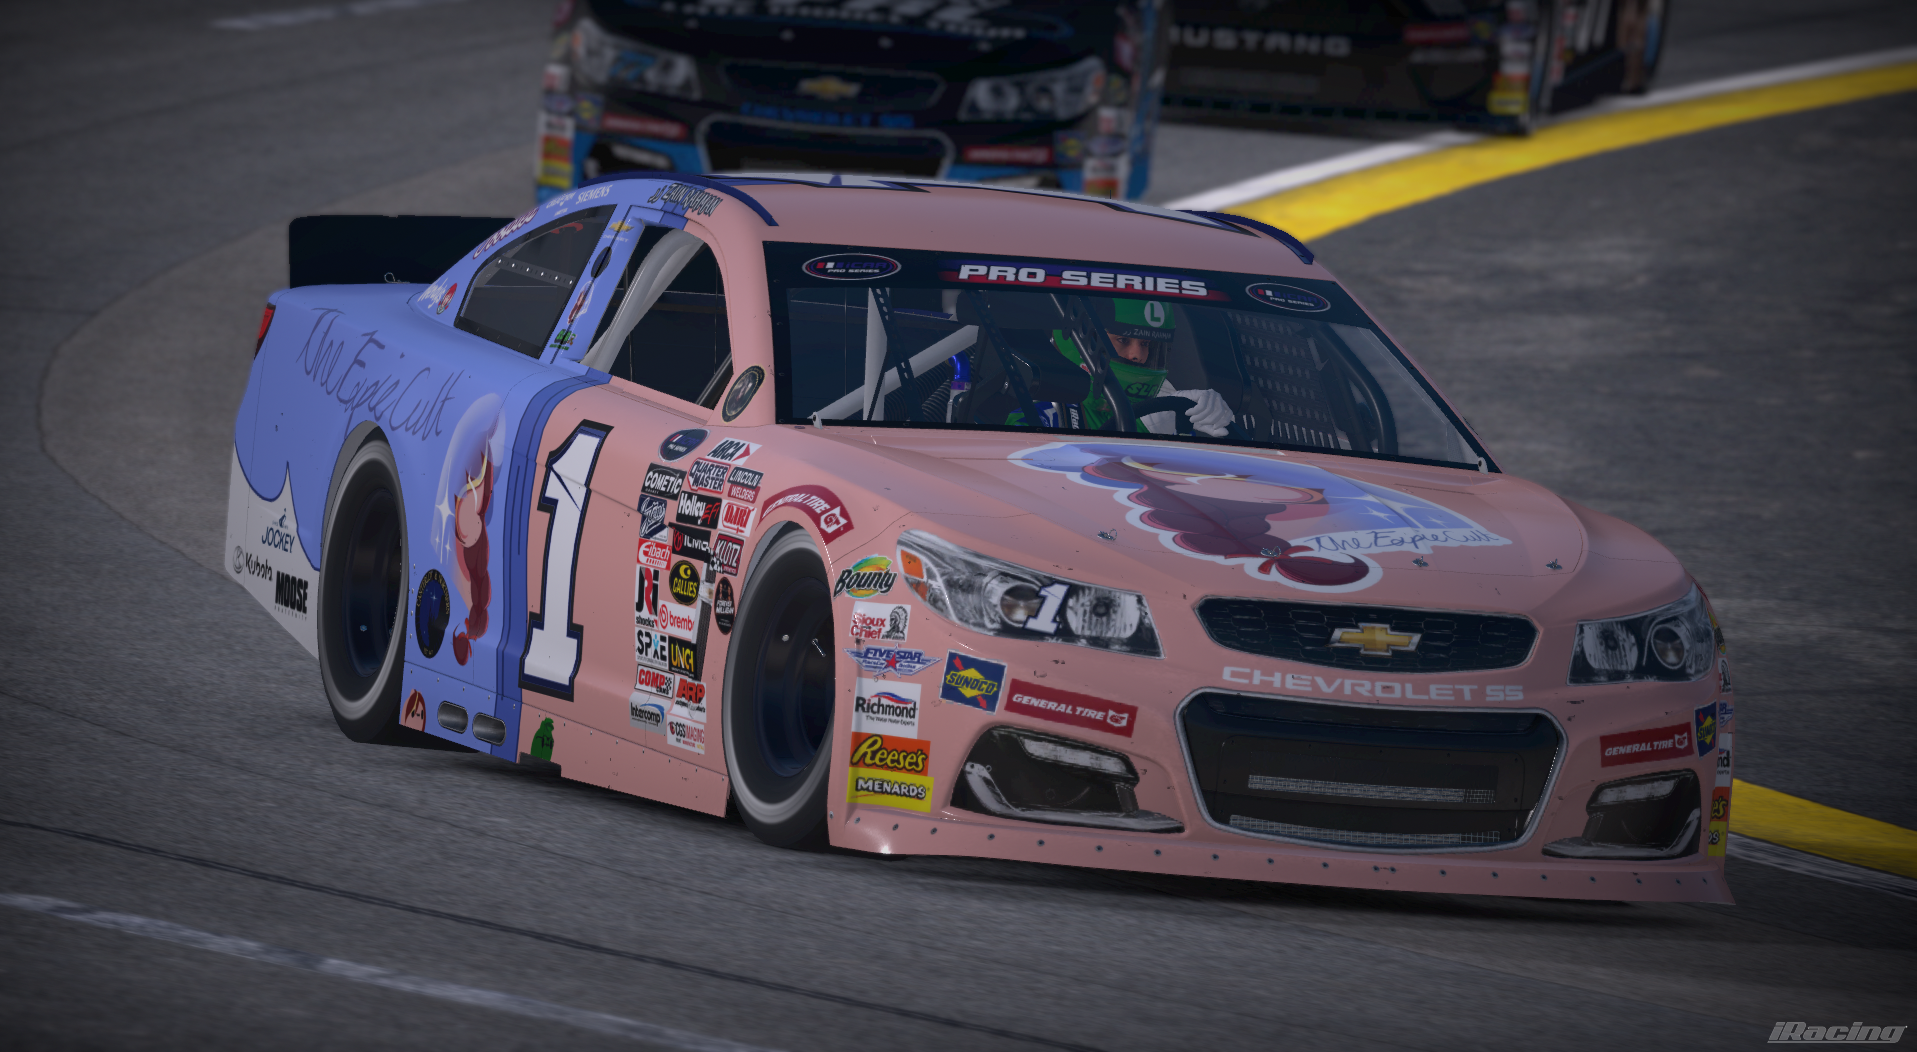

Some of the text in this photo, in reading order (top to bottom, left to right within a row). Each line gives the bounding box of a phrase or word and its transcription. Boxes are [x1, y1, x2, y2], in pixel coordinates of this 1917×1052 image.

[575, 184, 614, 205] SIEMENS
[659, 182, 691, 204] ZAIN
[679, 188, 723, 217] RAHMAN
[958, 264, 1208, 296] PRO SERIES
[1150, 303, 1161, 322] L
[1133, 328, 1151, 337] ZAIN
[295, 307, 346, 395] The
[389, 367, 465, 441] Cult
[706, 439, 746, 462] ARCA
[689, 461, 727, 479] QUARTER
[729, 469, 761, 488] LINCOLN
[644, 470, 683, 495] COMETIC
[692, 475, 725, 491] MASTER
[730, 485, 756, 502] WELDERS
[678, 492, 707, 526] Holley
[701, 502, 721, 525] EFI
[761, 493, 811, 519] GENERAL
[806, 495, 831, 514] TIRE
[261, 527, 295, 554] JOCKEY
[638, 541, 670, 563] Eibach
[1303, 535, 1373, 551] The
[519, 420, 613, 701] 1
[714, 539, 741, 568] KLOTZ
[245, 553, 273, 582] Kubota
[275, 570, 309, 614] MOOSE
[672, 577, 698, 598] CALLIES
[834, 569, 898, 597] Bounty
[1024, 582, 1071, 635] 1
[635, 615, 655, 628] shocks
[850, 625, 882, 639] Chief
[852, 613, 886, 628] Sioux
[864, 647, 923, 663] FIVE STAR
[638, 668, 666, 689] COMP
[946, 672, 998, 695] SUNOCO
[1222, 666, 1524, 702] CHEVROLET SS
[676, 677, 706, 704] ARP
[630, 702, 661, 728] Intercomp
[855, 696, 916, 719] Richmond
[1012, 693, 1106, 721] GENERAL TIRE
[850, 734, 928, 773] Reese's
[1604, 738, 1674, 757] GENERAL TIRE
[855, 776, 926, 800] MENARDS
